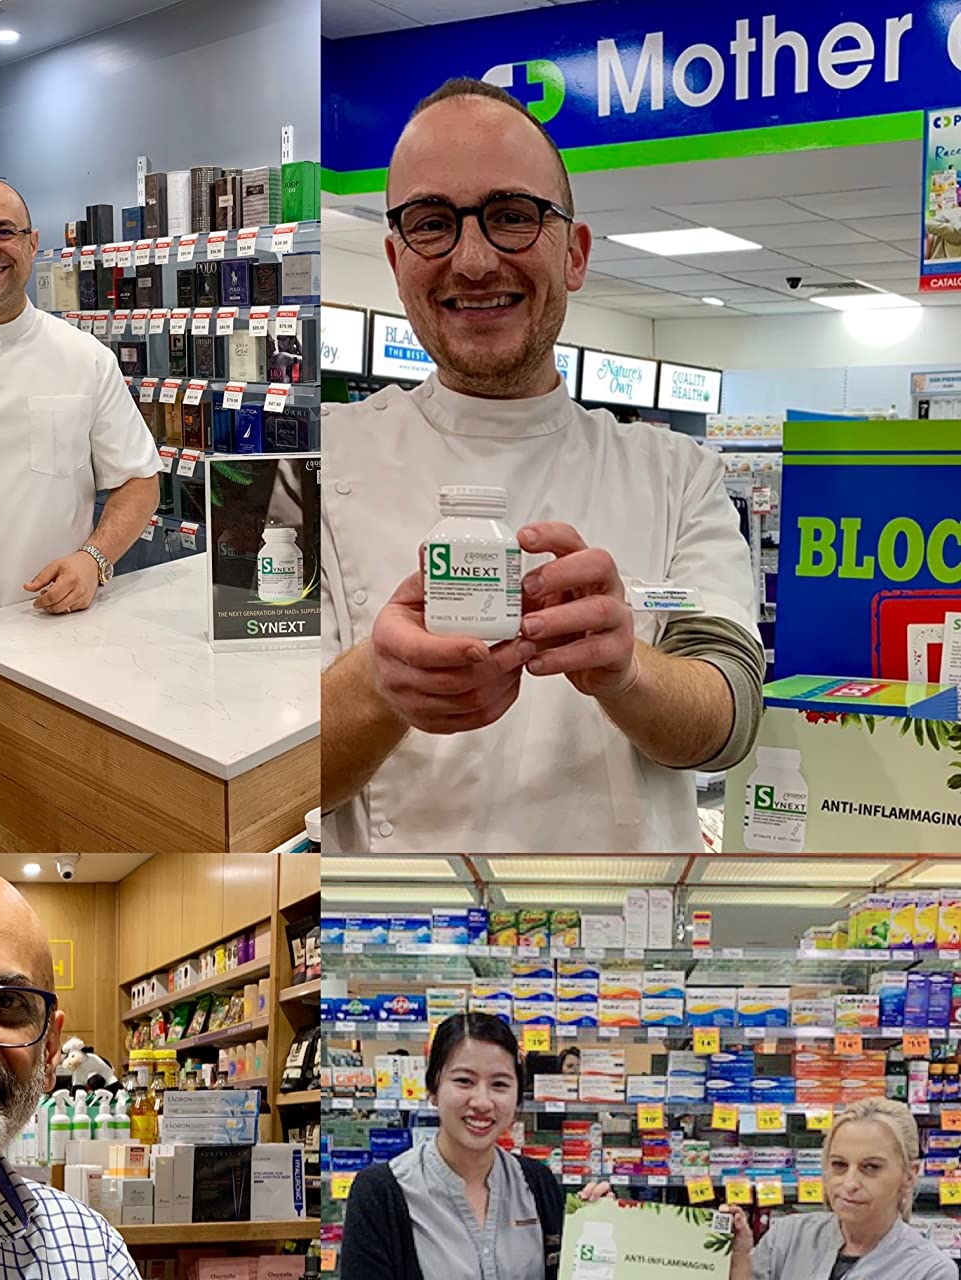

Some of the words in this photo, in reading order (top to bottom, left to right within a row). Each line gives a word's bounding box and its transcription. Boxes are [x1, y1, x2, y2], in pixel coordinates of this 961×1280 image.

[597, 14, 912, 117] Mother
[672, 372, 706, 387] QUALITY
[671, 385, 703, 402] HEALTH
[246, 619, 306, 636] SYNEXT
